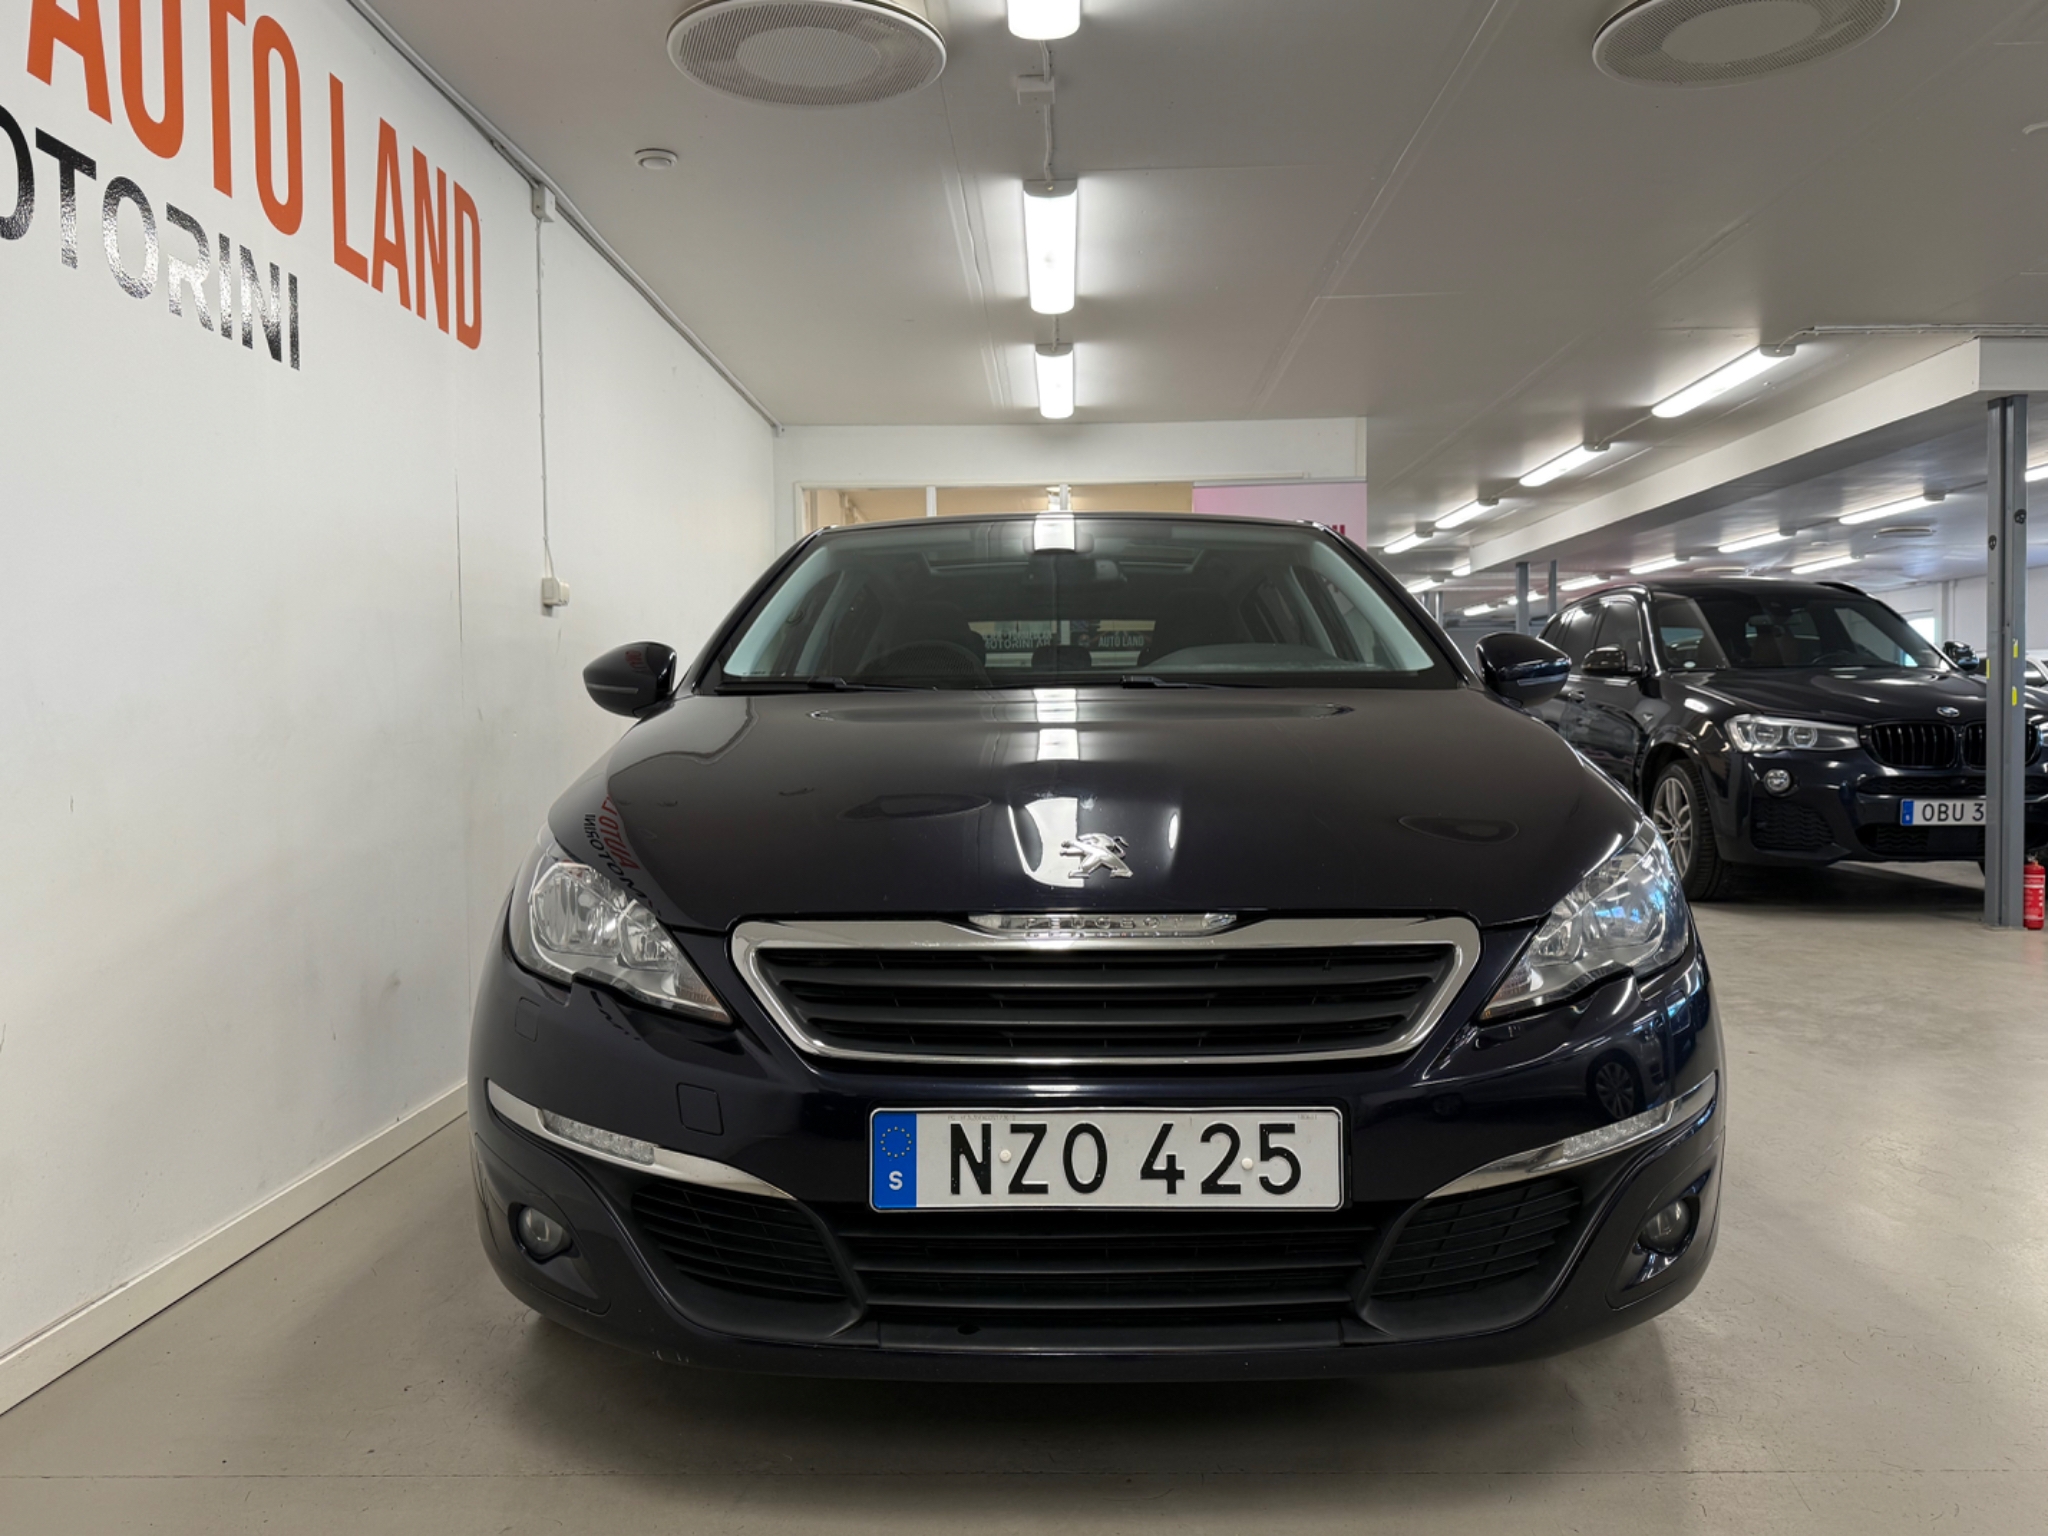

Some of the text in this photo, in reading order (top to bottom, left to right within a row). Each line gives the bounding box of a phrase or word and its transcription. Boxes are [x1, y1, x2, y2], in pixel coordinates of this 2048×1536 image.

[329, 72, 482, 350] LAND
[1122, 635, 1144, 647] LAND
[1922, 803, 1964, 822] OBU
[1026, 916, 1184, 930] PEUGEOT
[950, 1123, 1302, 1195] NZO 425
[889, 1170, 903, 1191] S
